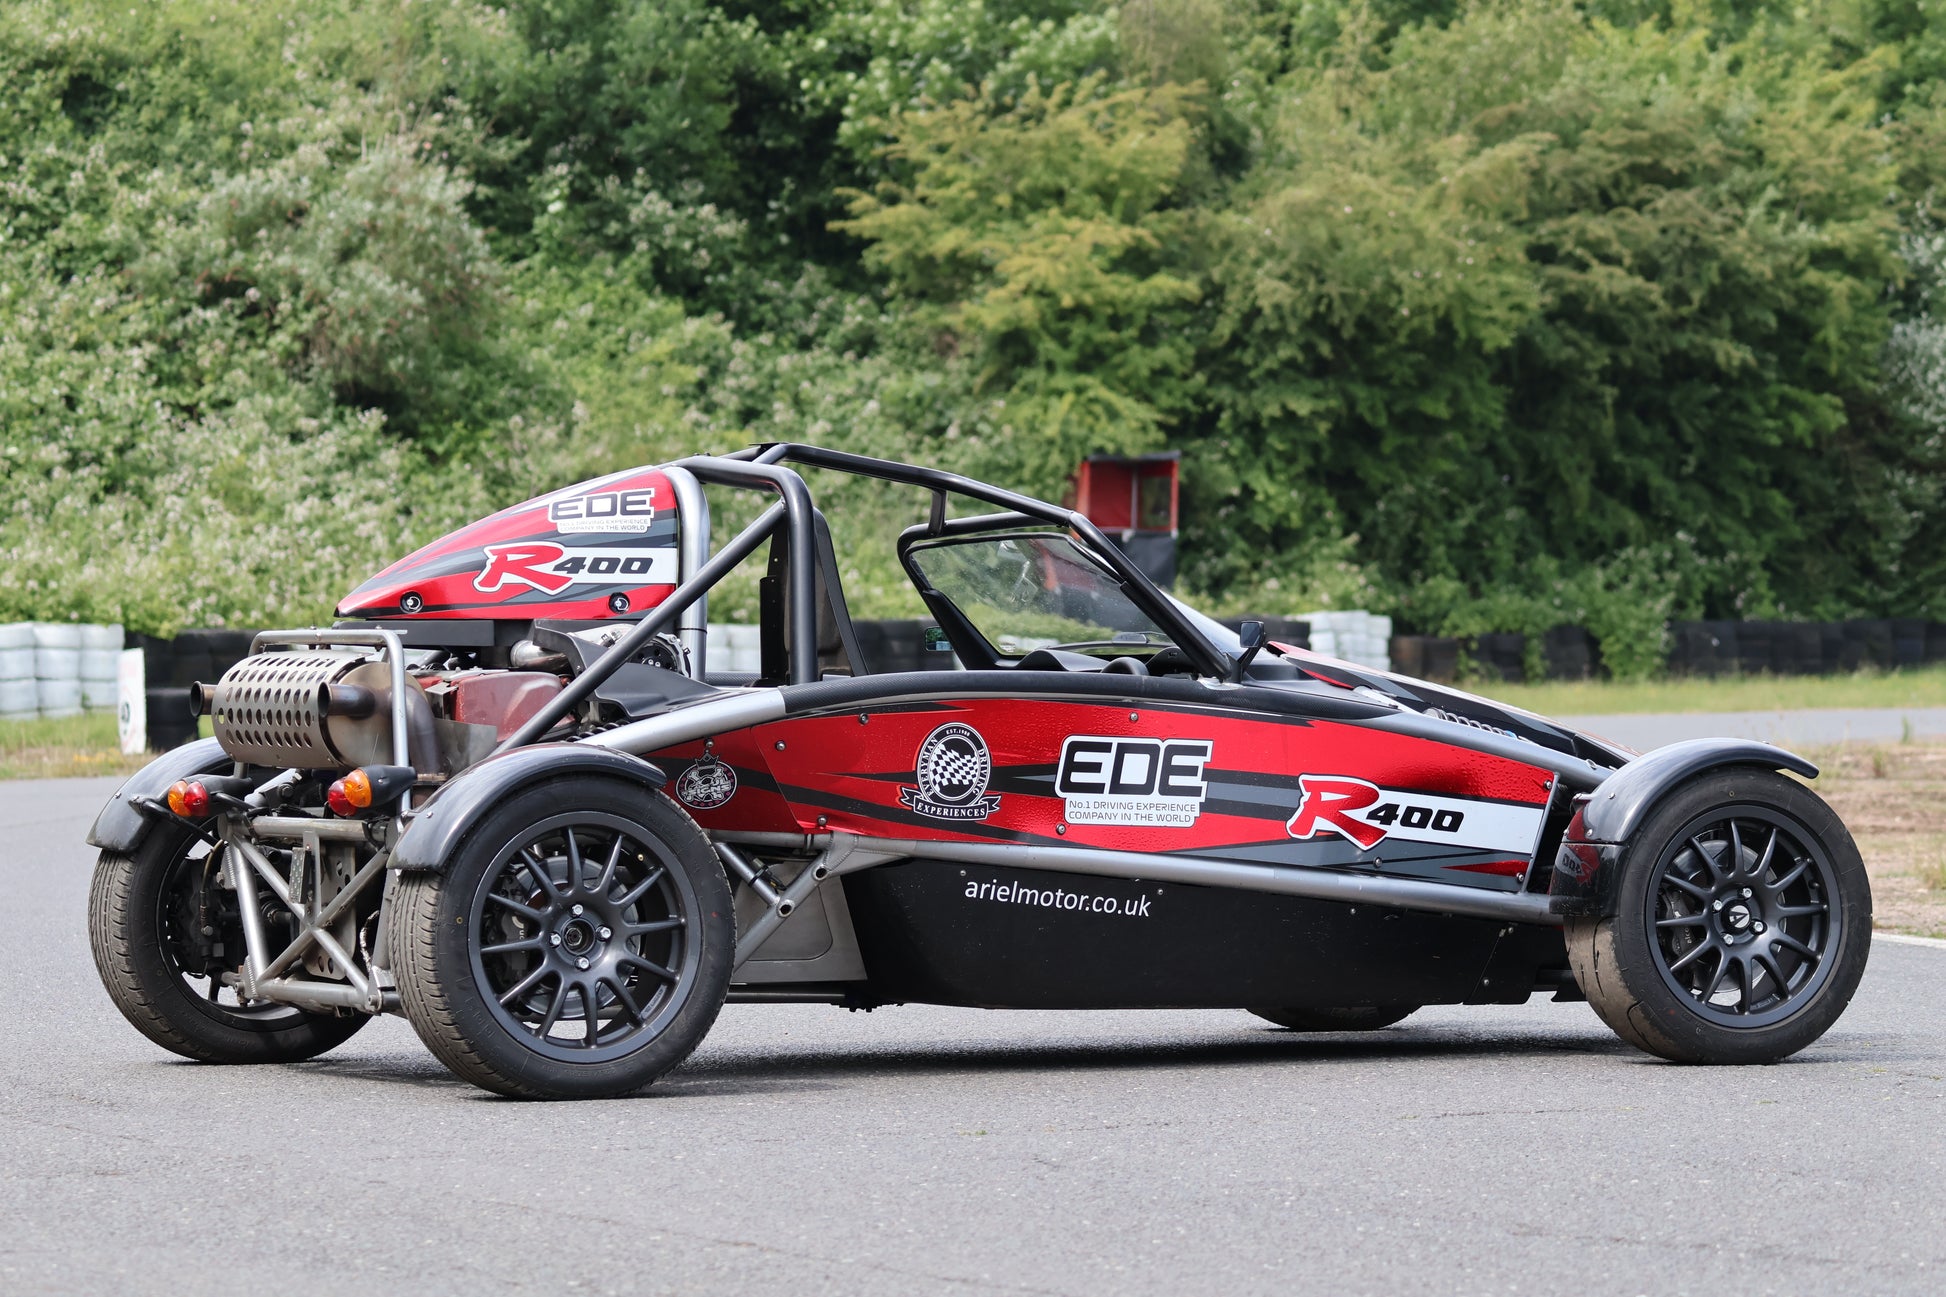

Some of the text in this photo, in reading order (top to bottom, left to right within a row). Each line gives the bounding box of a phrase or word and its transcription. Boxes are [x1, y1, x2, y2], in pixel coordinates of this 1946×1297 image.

[551, 489, 652, 520] EDE
[920, 737, 938, 797] EVERYMAN
[972, 748, 988, 796] DRIVING
[1059, 740, 1209, 798] EDE
[916, 802, 986, 817] EXPERIENCES
[1068, 811, 1191, 823] COMPANY IN THE WORLD
[1069, 800, 1196, 813] No.1 DRIVING EXPERIENCE
[964, 879, 1151, 917] arielmotor.co.uk
